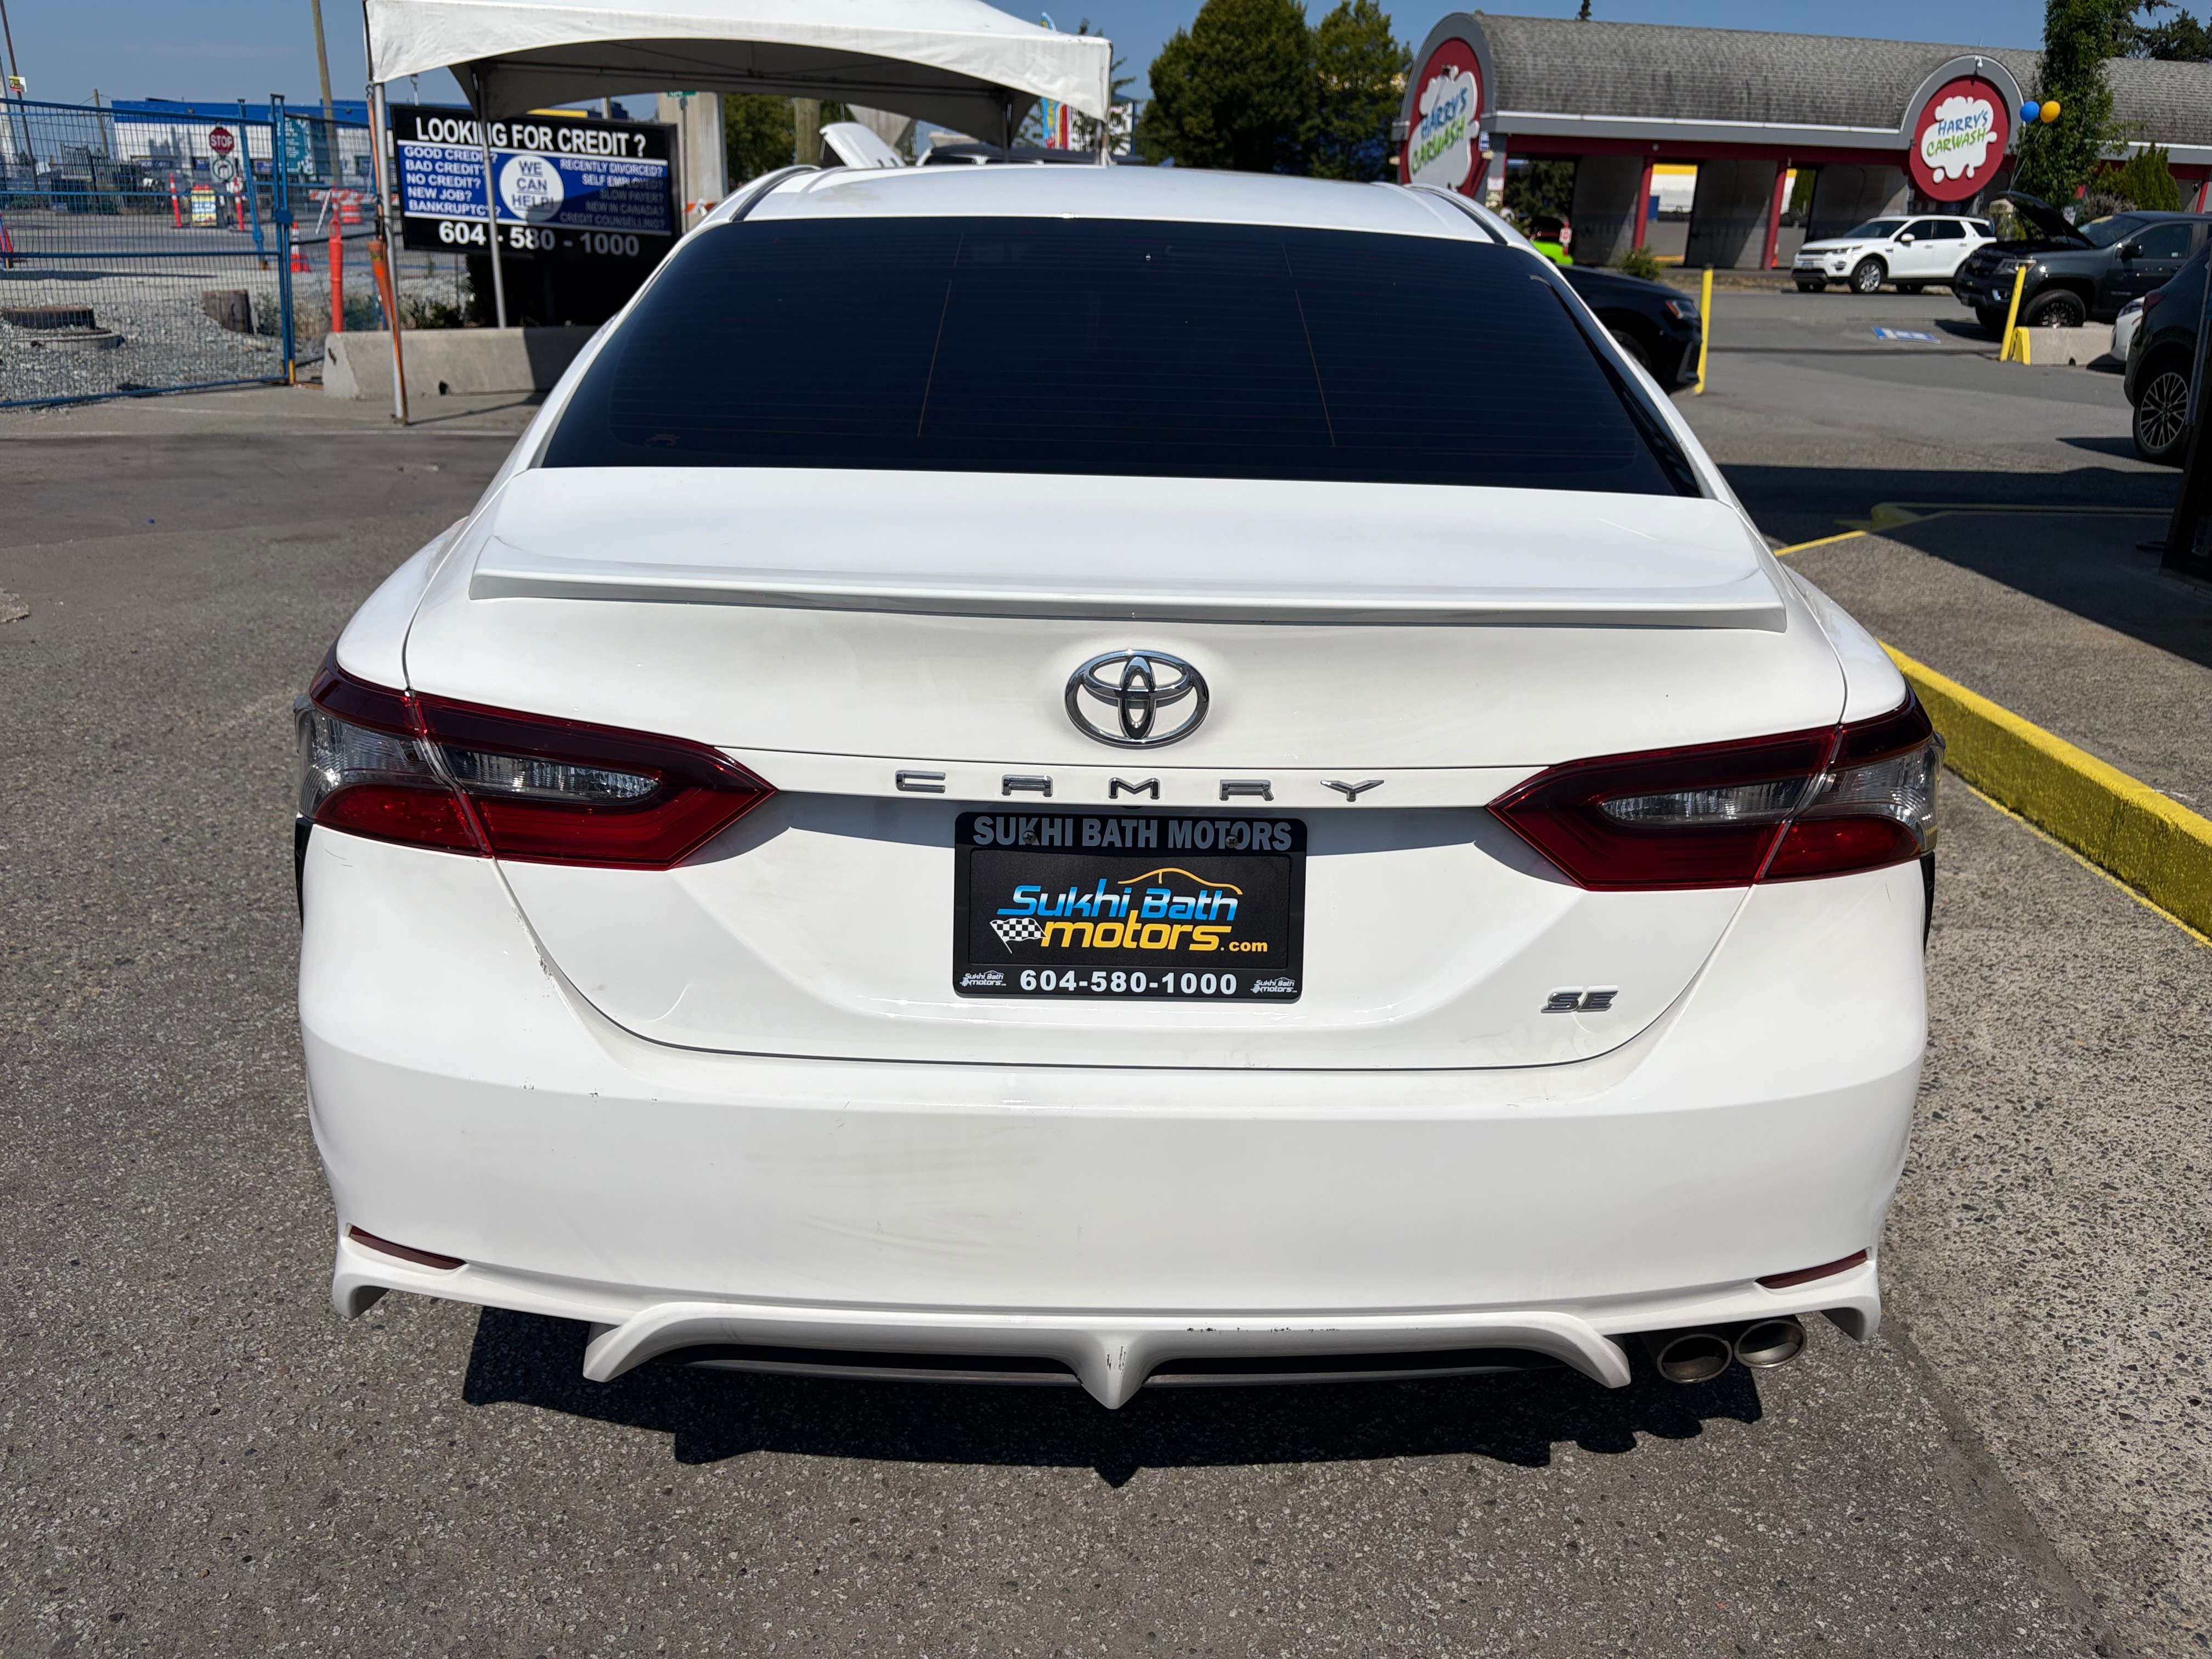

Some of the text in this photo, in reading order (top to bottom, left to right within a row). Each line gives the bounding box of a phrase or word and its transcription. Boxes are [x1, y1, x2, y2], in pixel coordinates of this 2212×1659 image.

[1938, 110, 1988, 136] HARRY'S
[211, 135, 233, 148] STOP
[511, 123, 555, 151] FOR
[557, 127, 630, 157] CREDIT
[1926, 127, 1987, 157] CARWASH
[404, 145, 498, 164] GOOD CREDI?
[405, 159, 433, 172] BAD
[518, 160, 543, 176] WE
[560, 158, 663, 178] RECENTLY DIVORCED?
[406, 172, 481, 189] NO CREDIT?
[517, 177, 548, 191] CAN
[582, 173, 663, 190] SELF EMPLOYED?
[407, 185, 472, 202] NEW JOB?
[599, 188, 628, 200] SLOW
[408, 199, 502, 217] BANKRUPTC?
[585, 200, 608, 212] NEW
[560, 211, 593, 223] CREDIT
[439, 221, 487, 246] 604
[510, 225, 556, 251] 580
[579, 232, 640, 257] 1000
[895, 769, 1386, 802] CAMRY
[973, 816, 1292, 851] SUKHI BATH MOTORS
[997, 878, 1239, 922] Sukhi Bath
[1019, 969, 1238, 995] 604-580-1000
[1541, 985, 1619, 1014] SE
